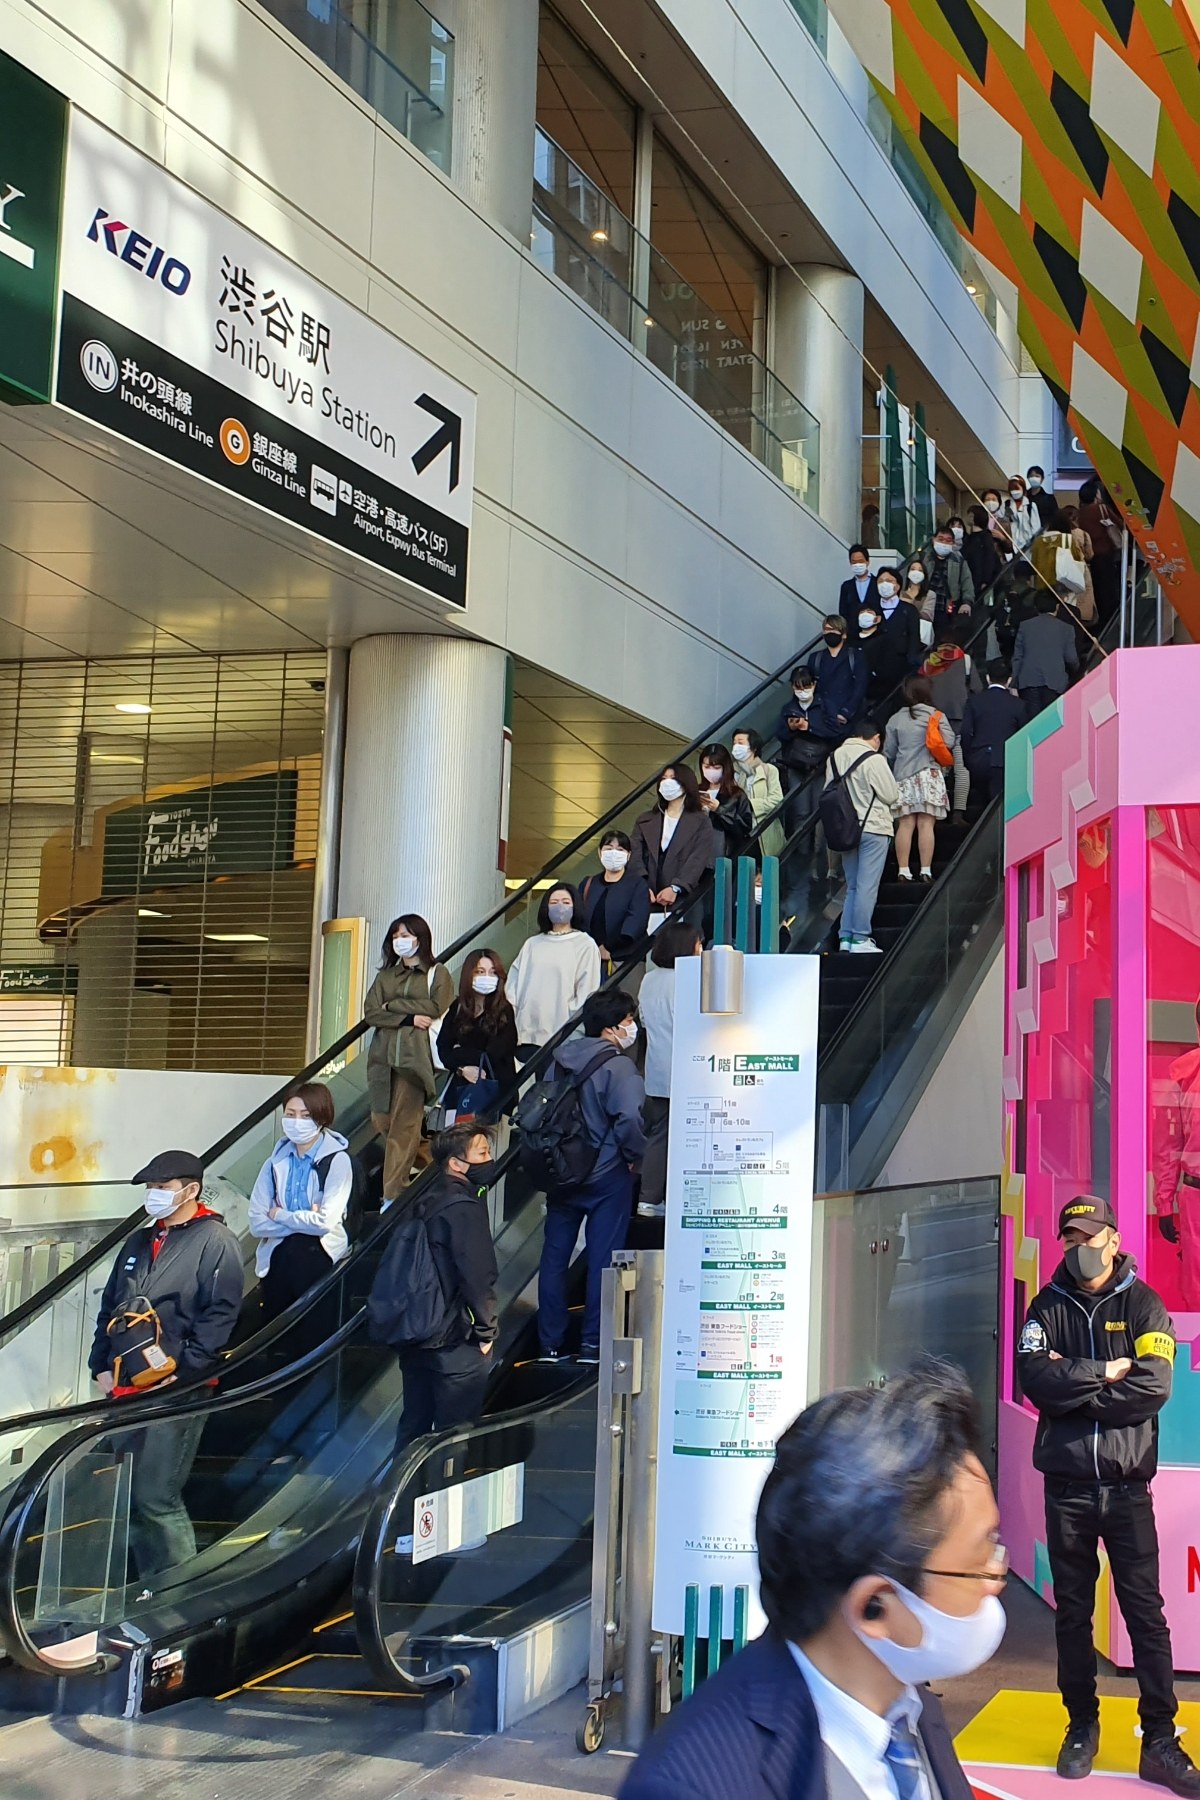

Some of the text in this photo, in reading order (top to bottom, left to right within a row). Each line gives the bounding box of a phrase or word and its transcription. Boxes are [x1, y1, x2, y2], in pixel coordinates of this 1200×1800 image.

[87, 207, 192, 296] KEIO
[219, 255, 331, 375] 渋谷駅
[89, 352, 110, 381] IN
[121, 358, 193, 417] 井の頭線
[215, 319, 396, 459] Shibuya Station
[121, 384, 214, 448] Inokashira Line
[230, 433, 241, 449] G
[252, 431, 298, 475] 銀座線
[252, 457, 307, 498] Ginza Line
[353, 513, 457, 578] Airport, Expwy Bus Terminal
[735, 1056, 794, 1071] EAST MALL
[685, 1540, 758, 1550] MARK CITY
